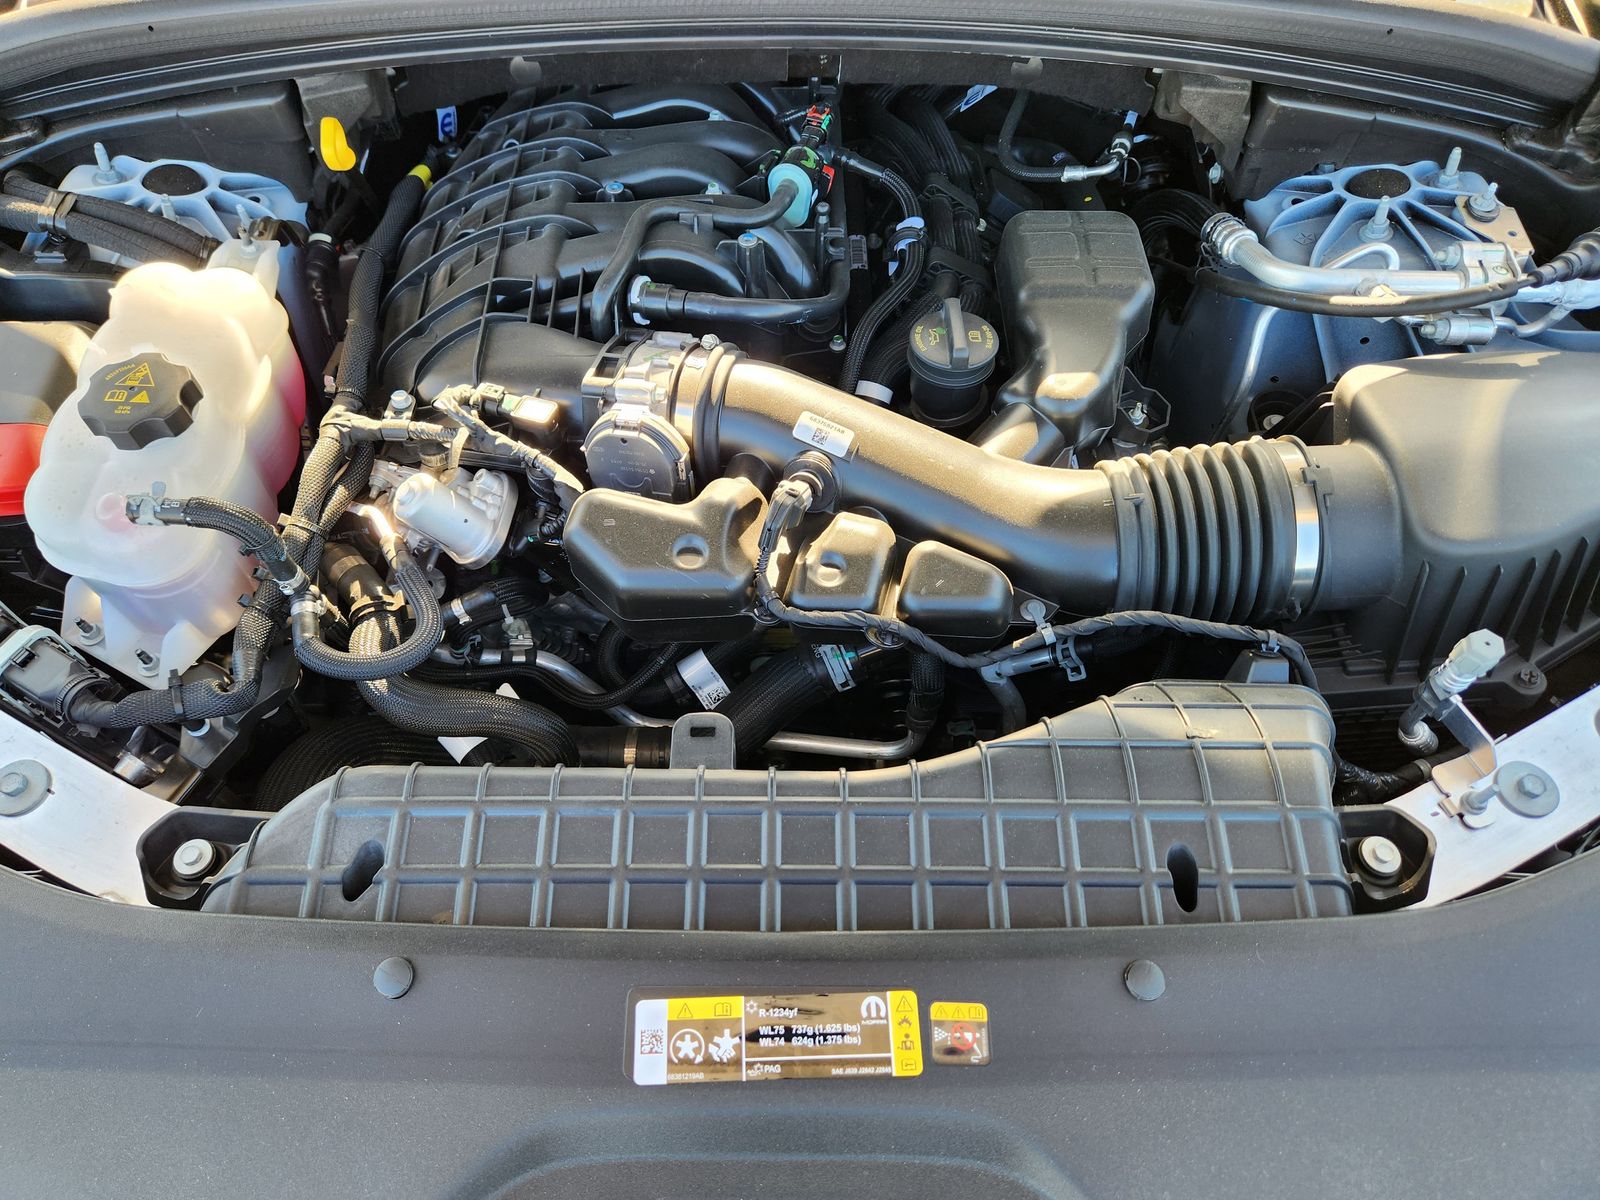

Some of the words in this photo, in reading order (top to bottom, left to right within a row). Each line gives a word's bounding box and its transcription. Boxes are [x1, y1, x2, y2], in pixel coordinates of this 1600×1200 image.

[759, 1007, 799, 1018] R-1234yf
[759, 1025, 785, 1035] WL75
[791, 1025, 813, 1036] 737g
[759, 1037, 785, 1047] WL74
[791, 1036, 814, 1047] 624g
[764, 1064, 781, 1073] PAG
